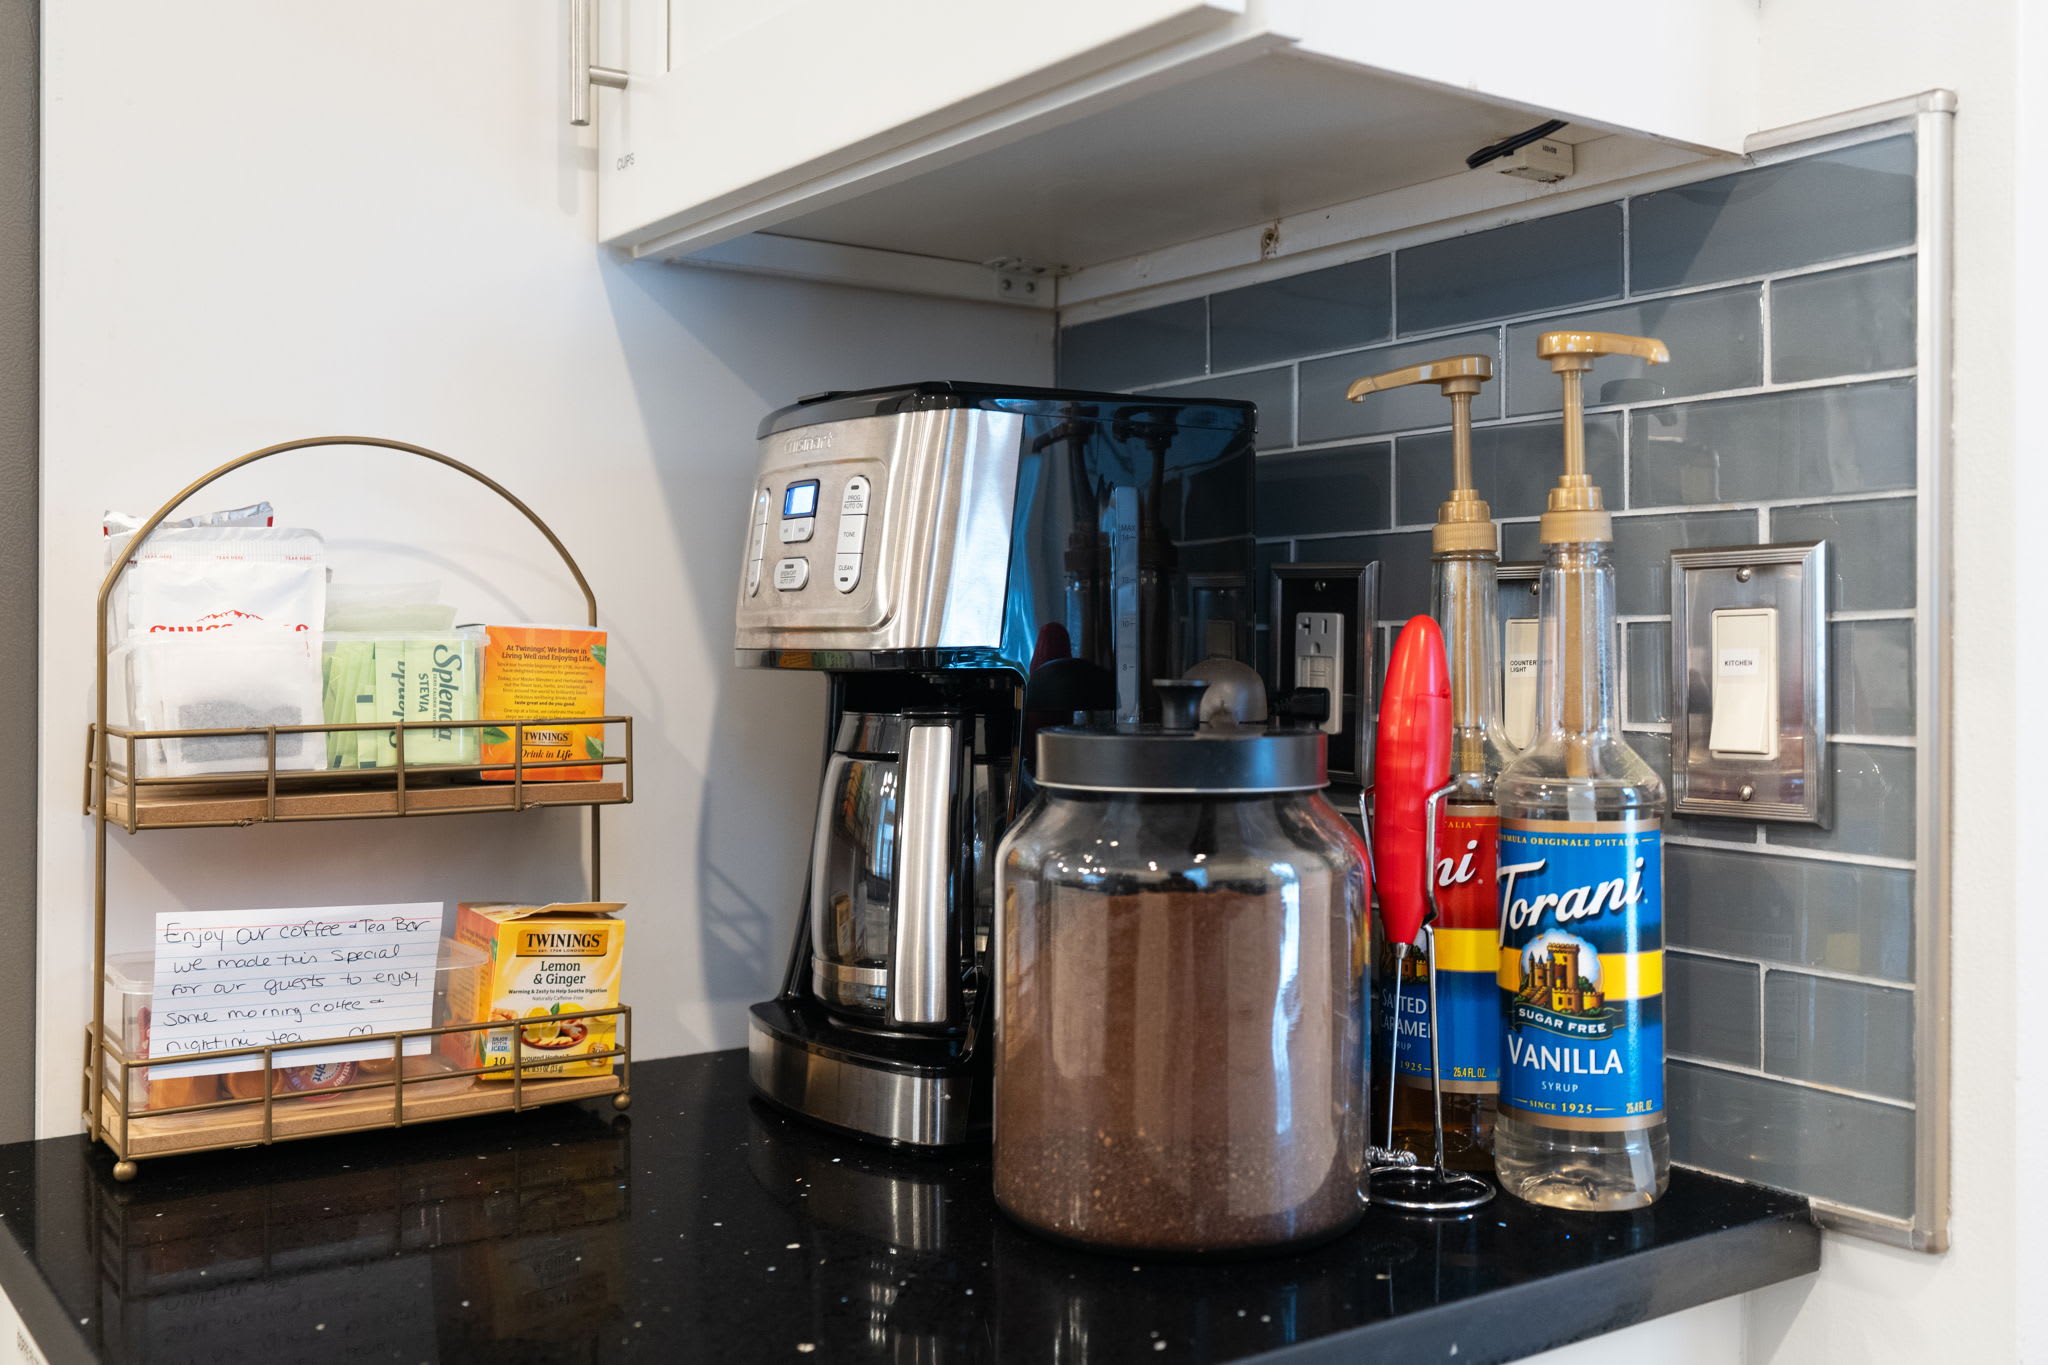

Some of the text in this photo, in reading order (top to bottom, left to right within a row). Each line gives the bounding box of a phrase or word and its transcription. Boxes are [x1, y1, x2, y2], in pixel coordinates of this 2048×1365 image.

[1120, 524, 1136, 532] MAX
[502, 652, 522, 660] Living
[551, 653, 578, 663] Enjoying
[1509, 659, 1537, 667] COUNTER
[1724, 659, 1753, 667] KITCHEN
[418, 673, 430, 713] STEVIA
[524, 731, 569, 741] TWININGS
[546, 750, 554, 758] in
[556, 749, 573, 761] Life
[1530, 837, 1591, 847] ORIGINALE
[1496, 857, 1645, 948] Torani
[164, 922, 224, 951] Enjoy
[360, 919, 385, 933] Tea
[392, 916, 431, 932] Bar
[527, 933, 600, 948] TWININGS
[218, 954, 272, 969] made
[540, 960, 581, 972] Lemon
[213, 982, 246, 994] our
[263, 974, 327, 996] guests
[340, 973, 362, 985] to
[372, 970, 418, 988] enjoy
[533, 973, 586, 987] & Ginger
[227, 1007, 303, 1023] morning
[1518, 1007, 1608, 1035] SUGAR FREE
[1507, 1033, 1624, 1075] VANILLA
[493, 1057, 506, 1066] 10
[1453, 1067, 1467, 1078] 25.4
[1541, 1080, 1579, 1093] SYRUP
[1529, 1100, 1593, 1114] SINCE 1925
